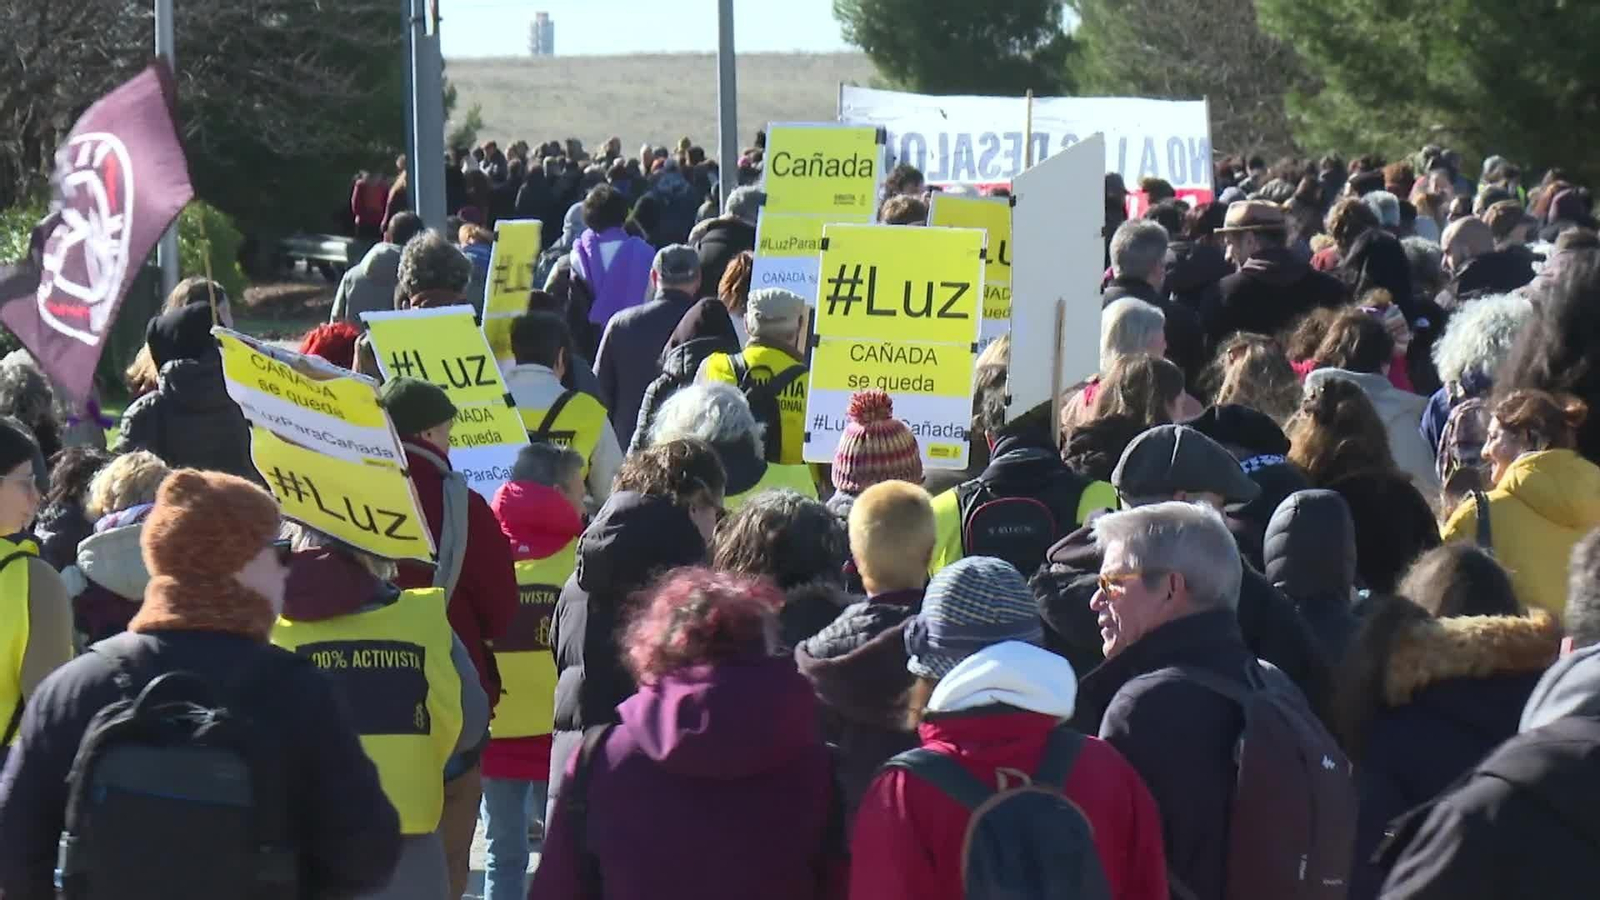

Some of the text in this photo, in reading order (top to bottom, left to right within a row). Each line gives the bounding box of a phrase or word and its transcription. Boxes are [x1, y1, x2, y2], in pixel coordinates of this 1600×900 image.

[772, 152, 873, 178] Cañada
[760, 236, 821, 251] #LuzPara
[826, 264, 971, 319] #Luz
[850, 342, 938, 365] CAÑADA
[390, 350, 497, 390] #Luz
[847, 374, 934, 392] se queda
[258, 379, 347, 420] se queda
[461, 429, 503, 449] queda
[268, 466, 418, 541] #Luz
[312, 649, 420, 671] 00% ACTIVISTA
